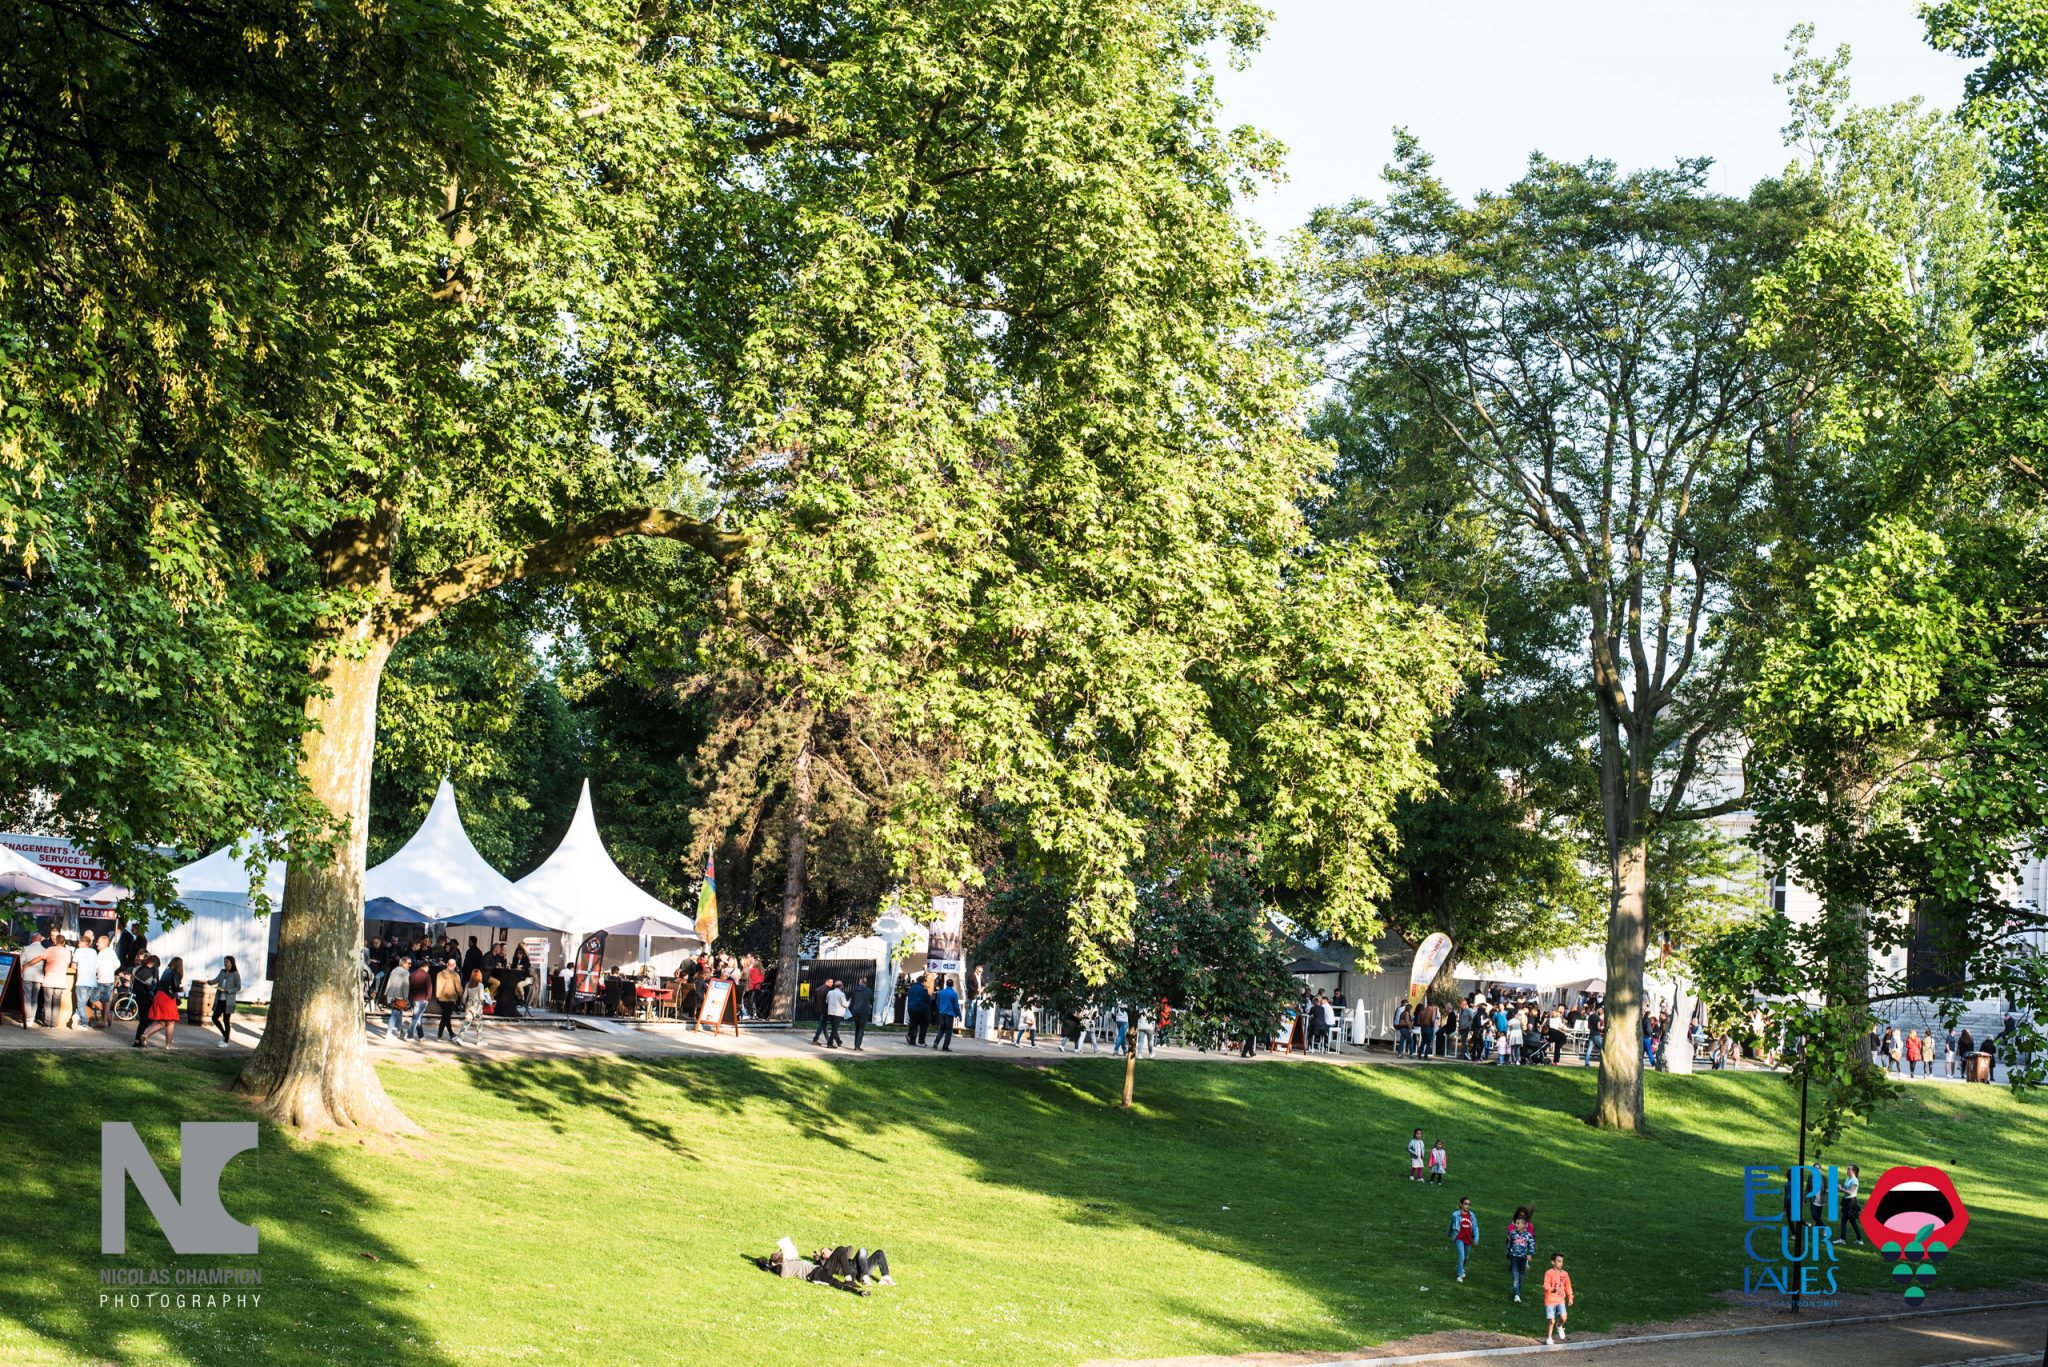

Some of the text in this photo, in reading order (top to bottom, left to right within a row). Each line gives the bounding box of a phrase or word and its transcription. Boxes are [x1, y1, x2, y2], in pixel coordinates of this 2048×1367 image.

[0, 841, 68, 855] ÉNAGEMENTS
[39, 853, 79, 865] SERVICE
[59, 868, 76, 877] +32
[79, 869, 91, 880] (0)
[94, 871, 100, 879] 4
